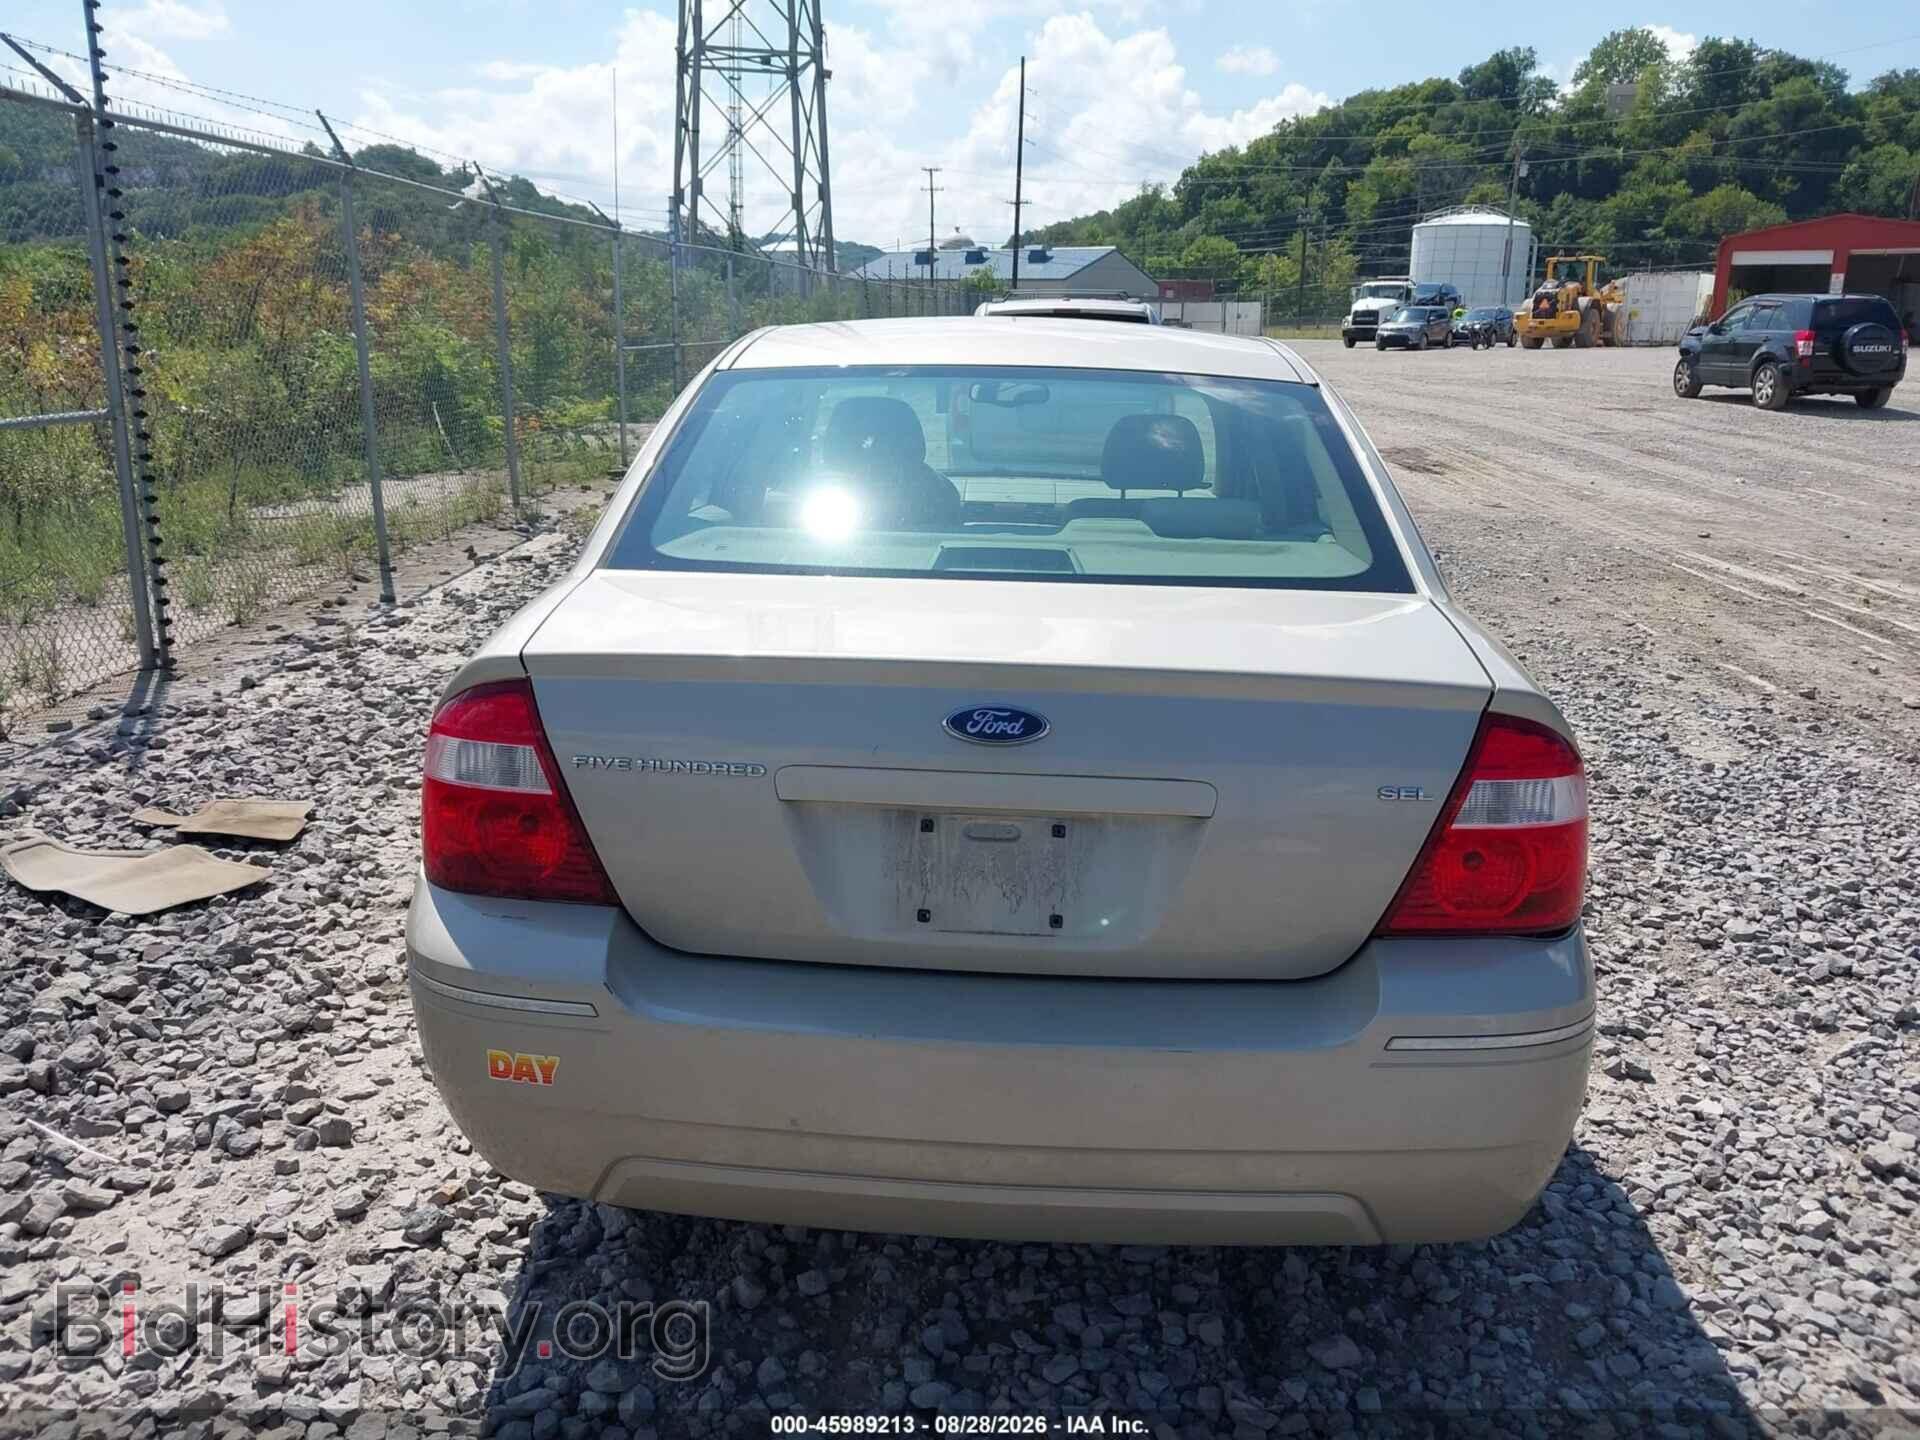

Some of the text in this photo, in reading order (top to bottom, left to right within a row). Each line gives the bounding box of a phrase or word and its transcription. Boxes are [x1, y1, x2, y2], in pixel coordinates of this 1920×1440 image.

[1852, 345, 1892, 353] SUZUKI
[967, 709, 1025, 734] Ford
[571, 754, 768, 777] FIVE HUNDRED
[1377, 785, 1433, 801] SEL
[487, 1049, 560, 1086] DAY
